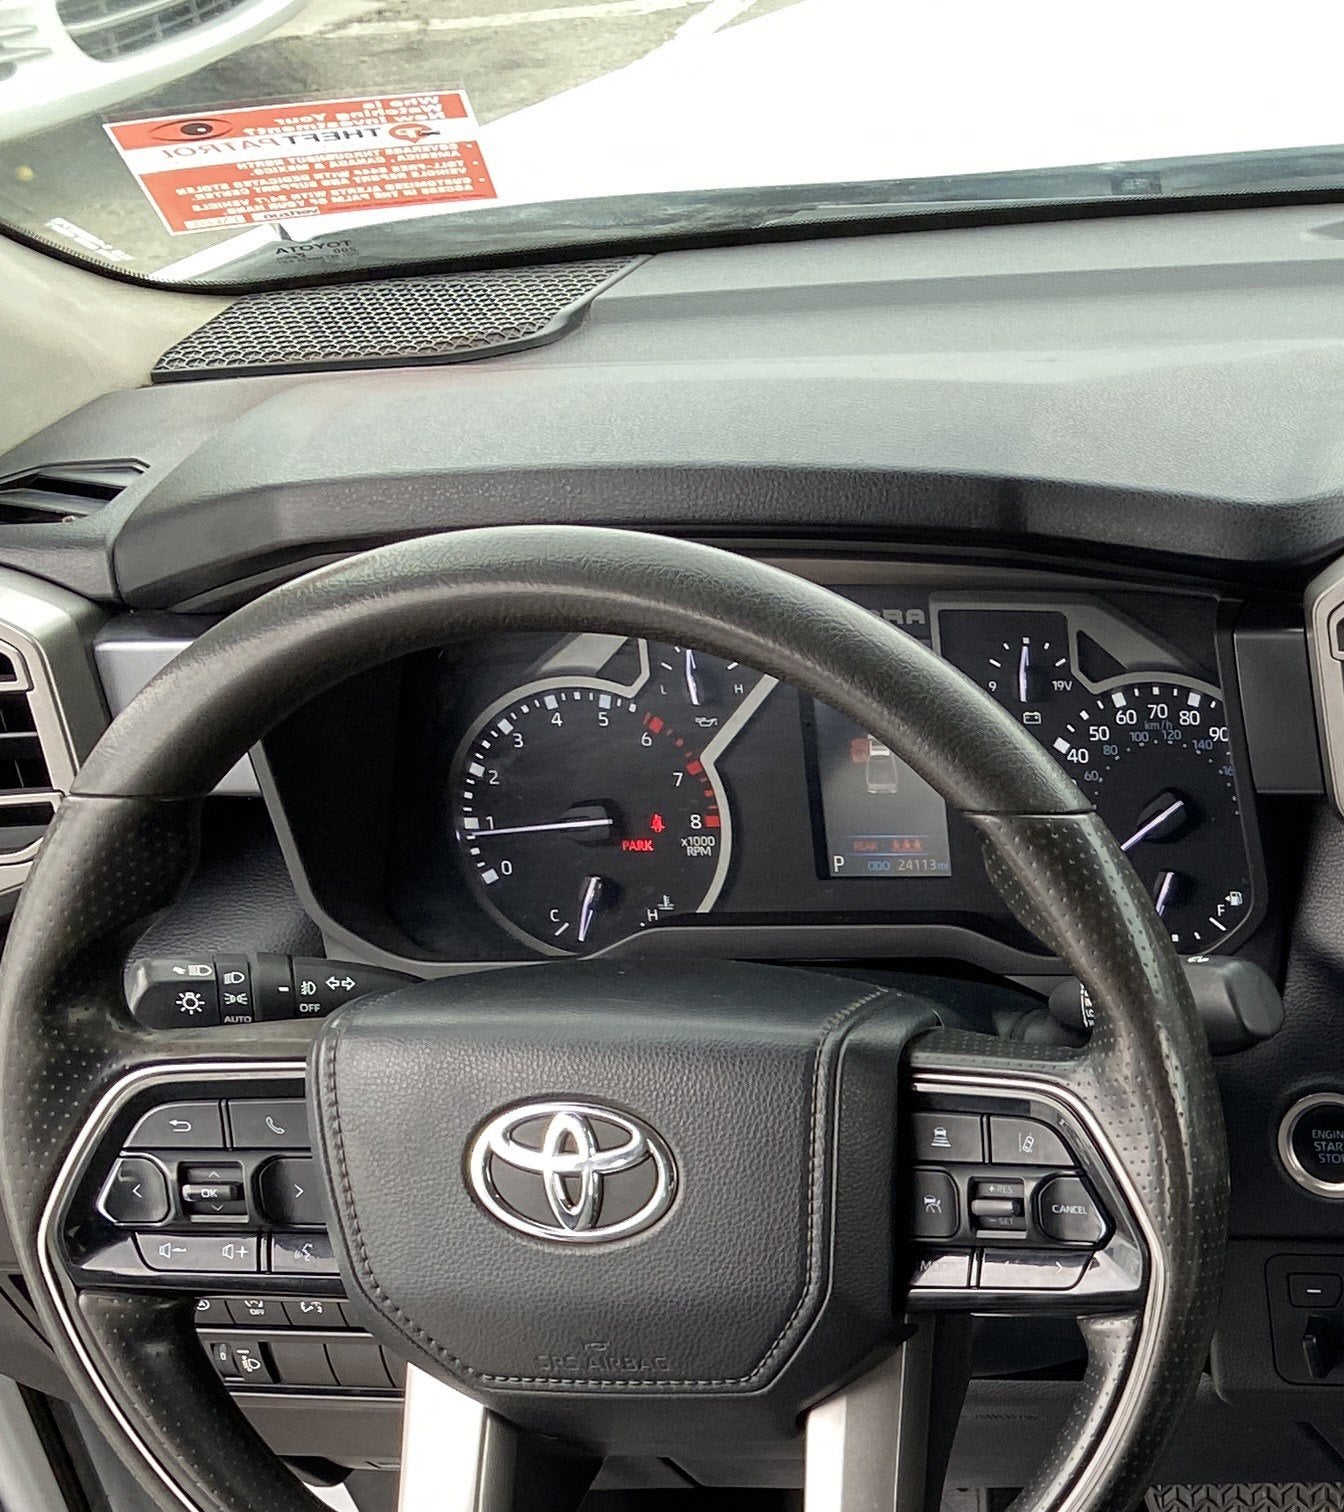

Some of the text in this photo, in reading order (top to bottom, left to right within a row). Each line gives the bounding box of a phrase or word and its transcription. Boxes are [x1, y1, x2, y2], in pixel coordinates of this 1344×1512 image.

[734, 683, 744, 695] H
[1052, 680, 1073, 692] 19V
[1115, 710, 1138, 725] 60
[1147, 703, 1169, 719] 70
[1179, 710, 1201, 726] 80
[550, 712, 564, 727] 4
[598, 712, 610, 727] 5
[512, 733, 524, 748] 3
[640, 732, 653, 747] 6
[1089, 726, 1110, 741] 50
[1130, 731, 1149, 742] 100
[1162, 730, 1182, 741] 120
[1208, 726, 1230, 742] 90
[1103, 744, 1118, 756] 80
[1192, 739, 1214, 750] 140
[1067, 748, 1089, 764] 40
[488, 769, 500, 785] 2
[672, 772, 684, 787] 7
[1083, 770, 1099, 782] 60
[486, 815, 496, 830] 1
[690, 814, 702, 829] 8
[622, 839, 654, 851] PARK
[687, 846, 712, 857] RPM
[501, 861, 513, 876] 0
[833, 855, 845, 872] P
[898, 859, 937, 871] 24113
[647, 908, 659, 922] H
[1216, 904, 1226, 917] F
[300, 1003, 321, 1013] OFF
[224, 1015, 252, 1024] AUTO
[201, 1187, 218, 1199] OK
[1051, 1204, 1088, 1215] CANCEL
